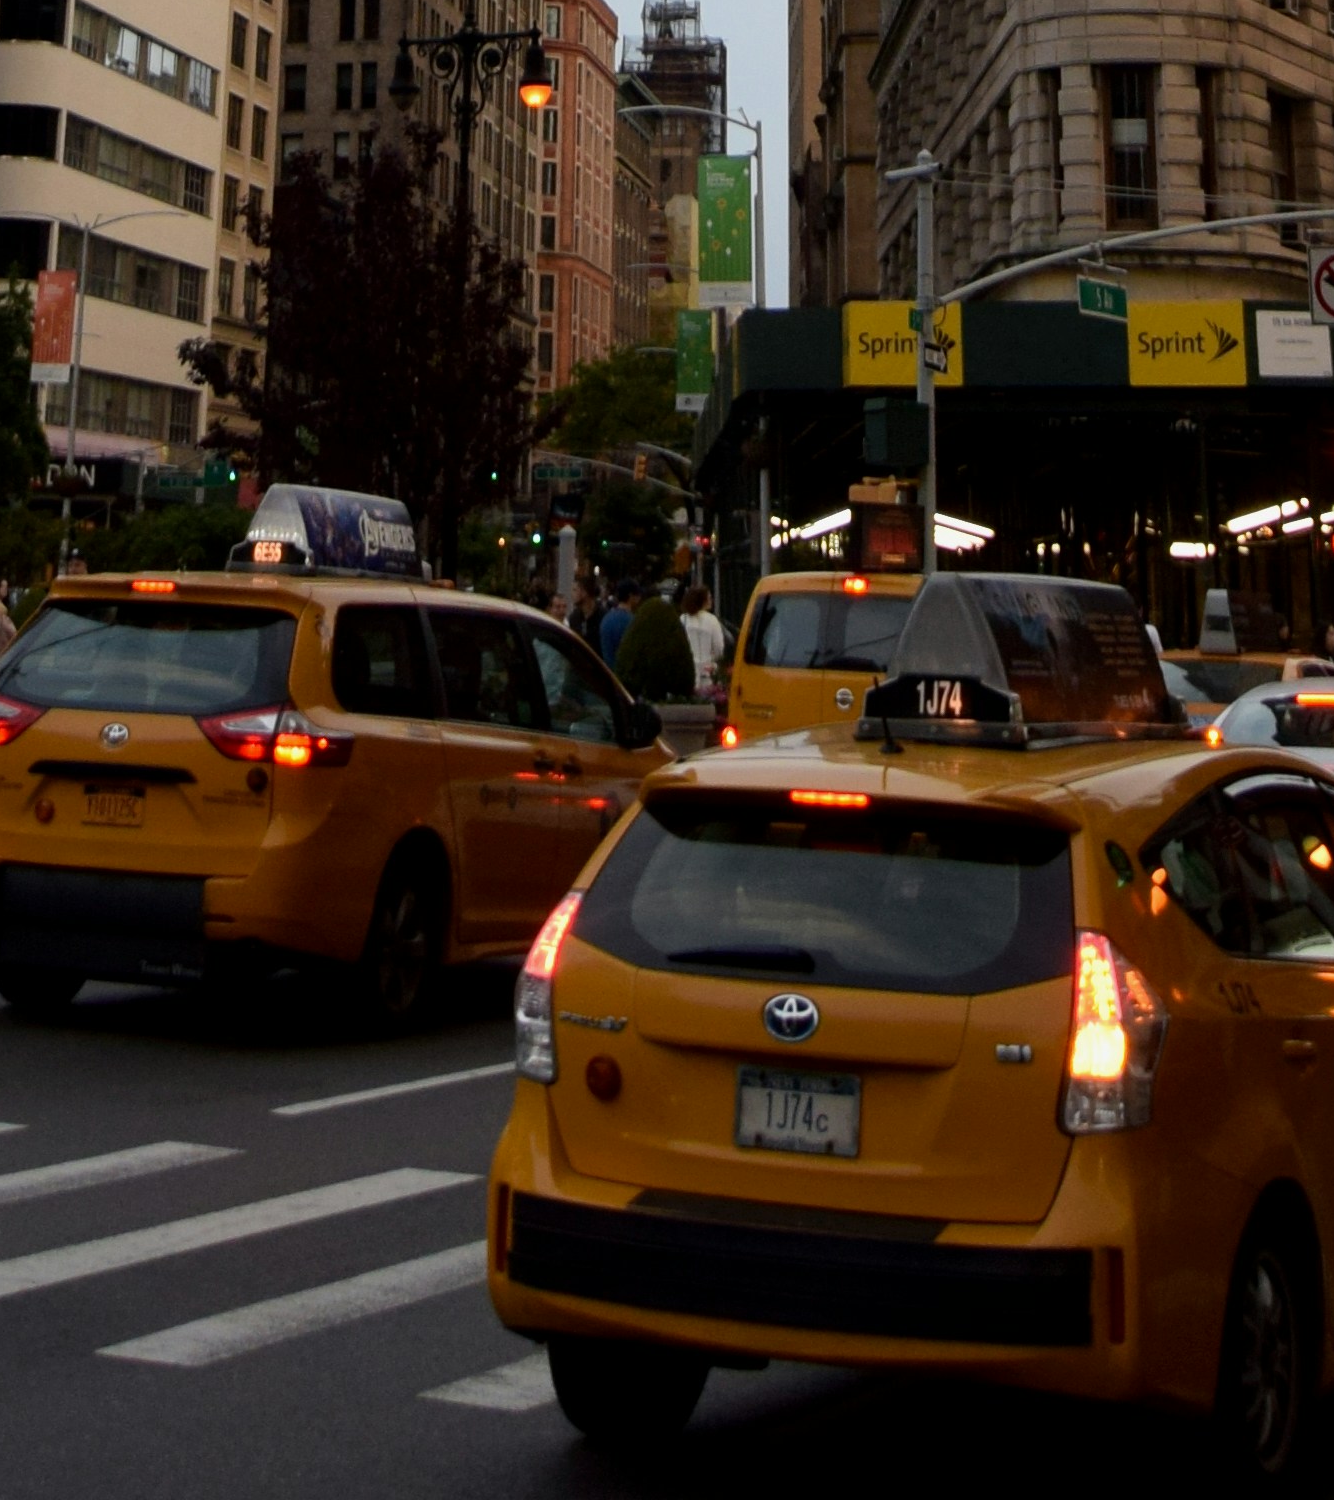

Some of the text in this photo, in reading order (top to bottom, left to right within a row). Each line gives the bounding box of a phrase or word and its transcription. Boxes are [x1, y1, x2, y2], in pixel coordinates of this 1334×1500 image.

[858, 331, 918, 360] Sprin
[1137, 331, 1205, 360] Sprint
[916, 679, 963, 717] 1J74
